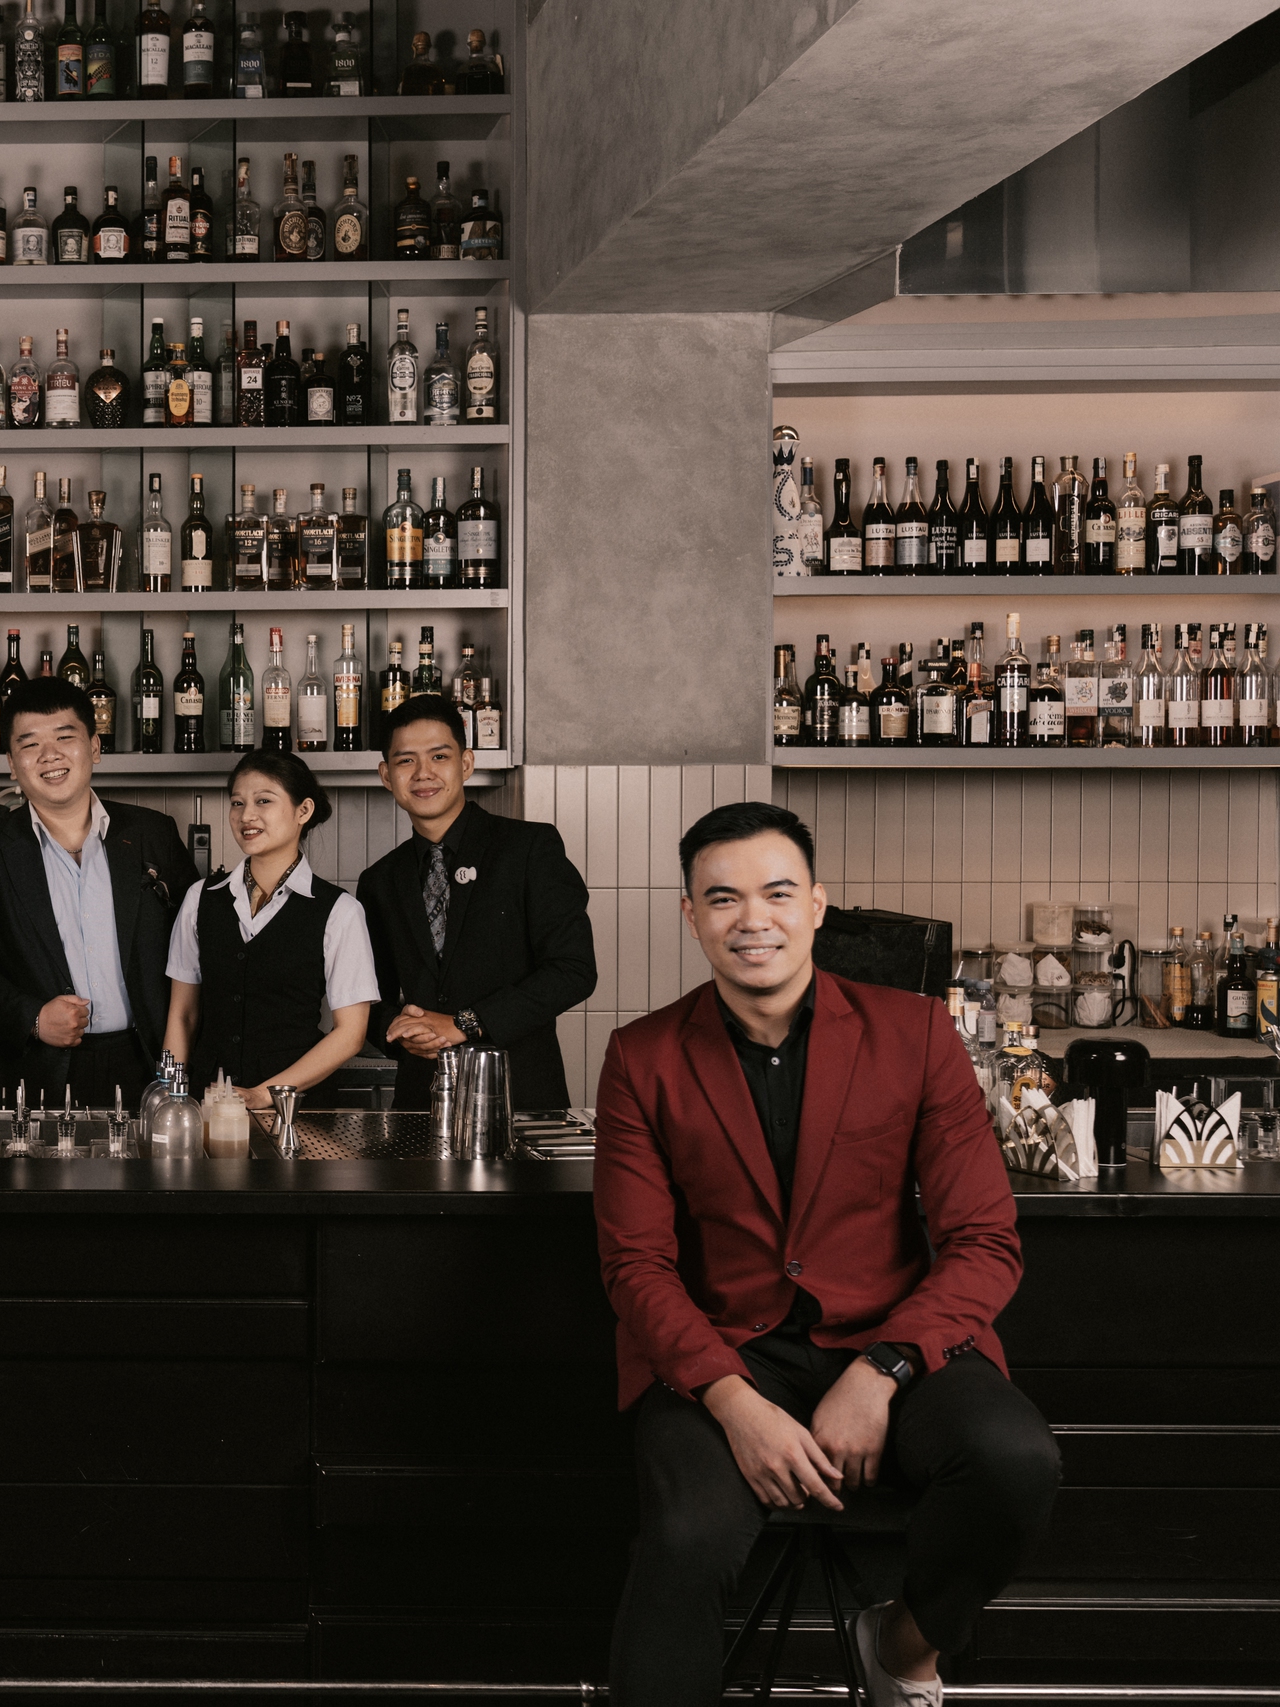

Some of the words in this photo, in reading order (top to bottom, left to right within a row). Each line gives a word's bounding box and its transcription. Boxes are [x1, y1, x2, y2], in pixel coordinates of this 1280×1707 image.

[240, 59, 261, 68] 1800
[334, 58, 355, 68] 1800
[246, 376, 258, 385] 24
[1118, 510, 1146, 519] LILLE
[234, 529, 265, 537] MORTLACH
[302, 528, 335, 536] MORTLACH
[901, 525, 927, 533] LUSTAU
[313, 538, 322, 546] 16
[335, 675, 361, 683] AVERNA
[1104, 707, 1128, 715] VODKA
